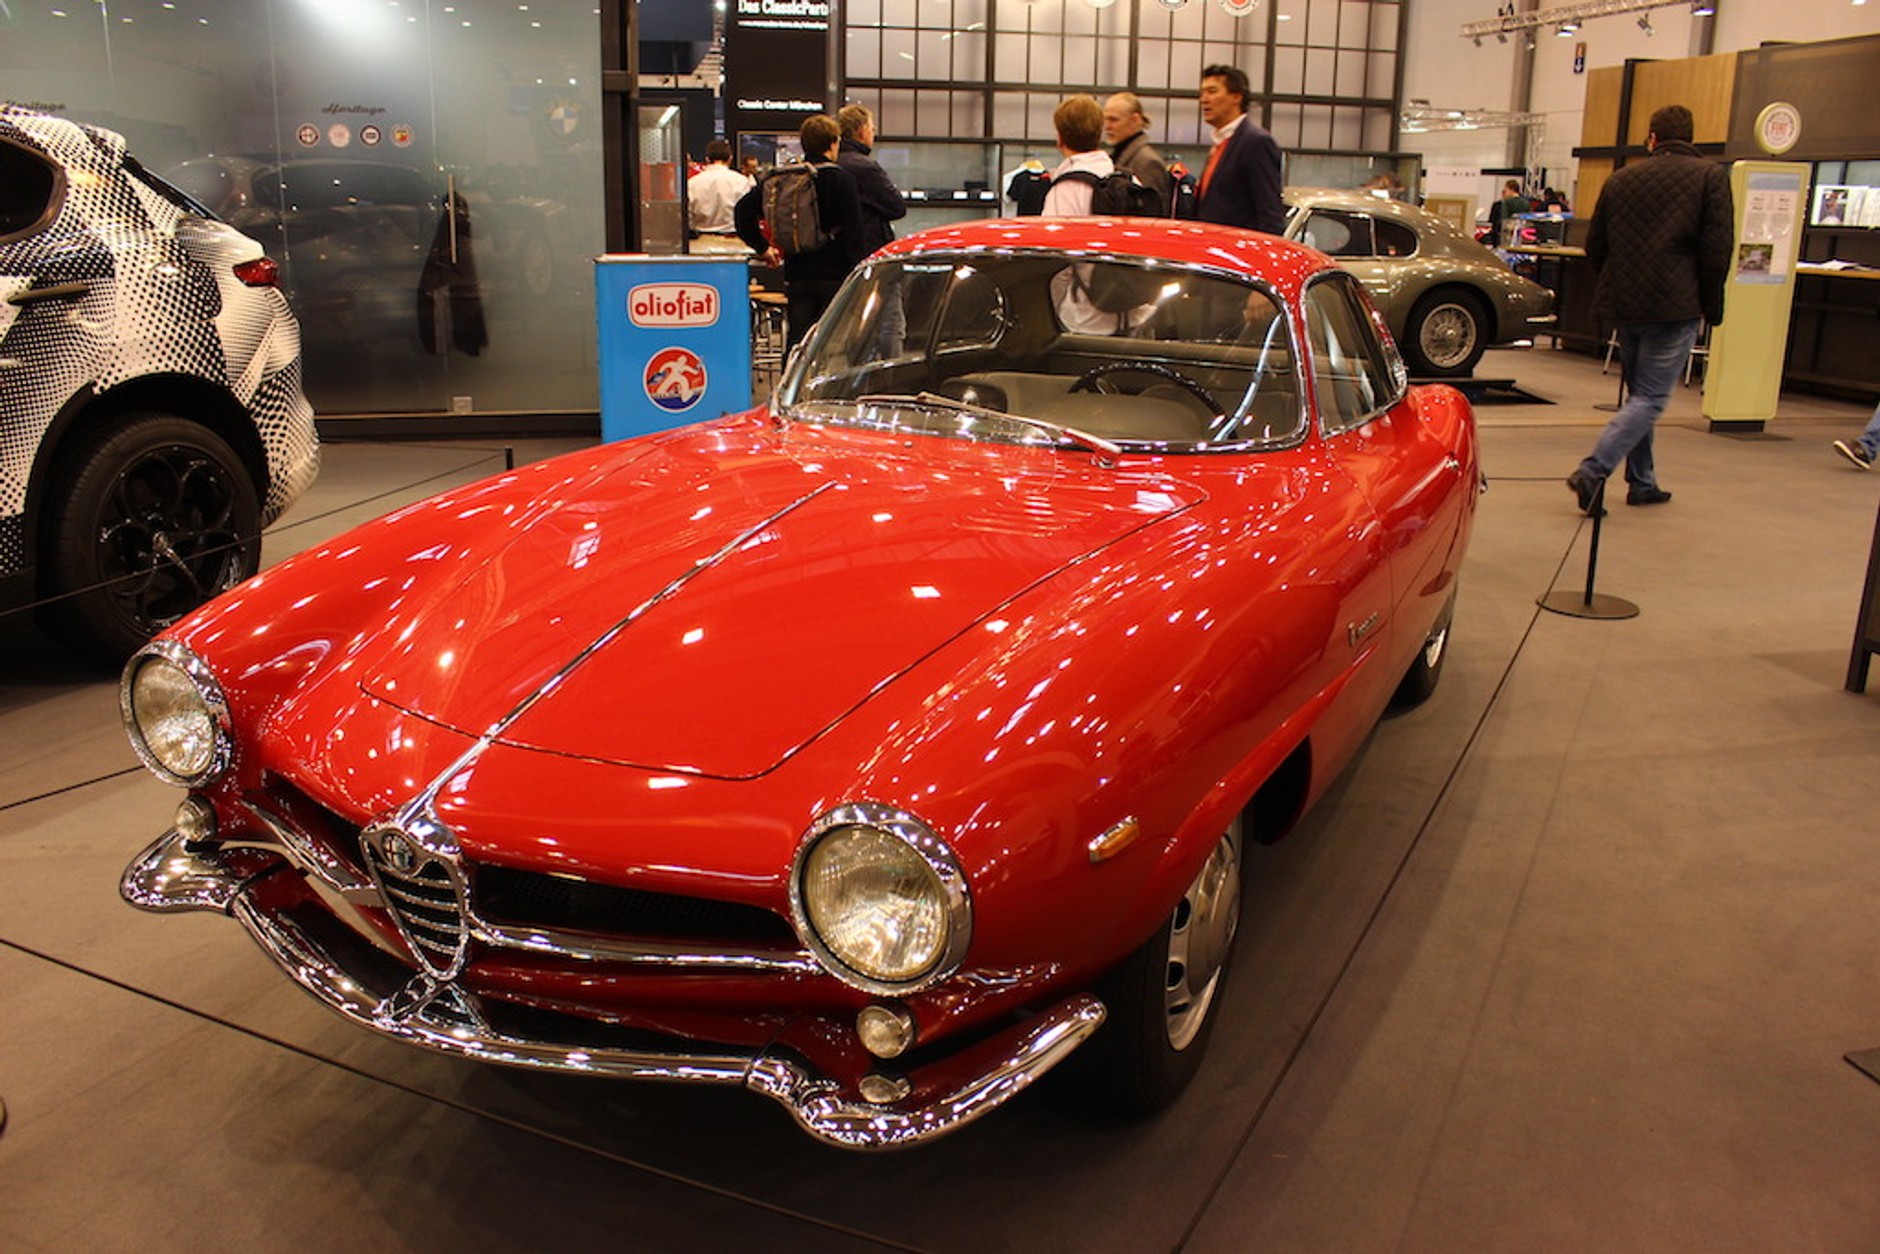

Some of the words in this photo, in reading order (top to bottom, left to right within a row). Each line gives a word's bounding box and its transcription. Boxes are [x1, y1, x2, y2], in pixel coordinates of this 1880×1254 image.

[738, 0, 761, 14] Das
[321, 103, 385, 116] Heritage
[738, 99, 762, 110] Classic
[764, 99, 787, 110] Center
[635, 289, 712, 320] oliofiat
